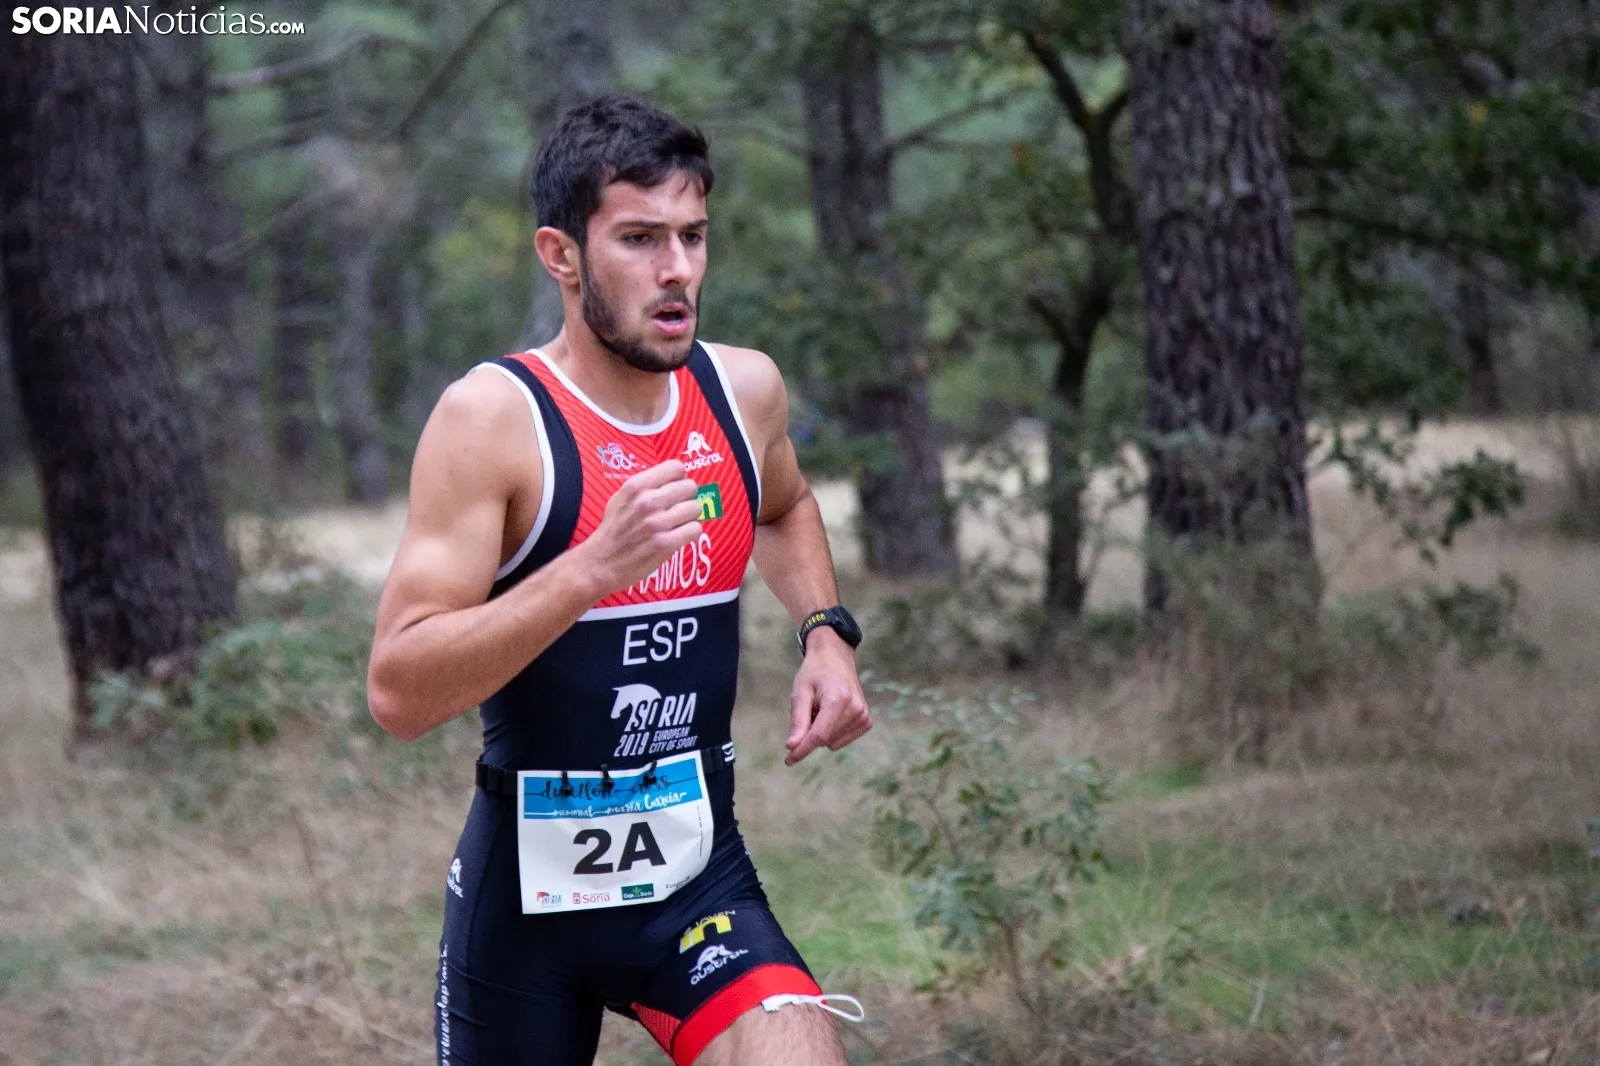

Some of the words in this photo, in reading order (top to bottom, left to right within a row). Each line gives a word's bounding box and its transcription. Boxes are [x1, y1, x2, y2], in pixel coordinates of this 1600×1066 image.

[627, 532, 711, 595] AMOS
[622, 616, 699, 666] ESP
[633, 692, 697, 730] SORIA
[613, 732, 650, 757] 2019
[649, 741, 667, 754] CITY
[667, 740, 676, 751] OF
[676, 735, 698, 750] SPORT
[653, 726, 690, 742] EUROPEAN
[573, 821, 667, 875] 2A
[582, 892, 611, 905] Soria
